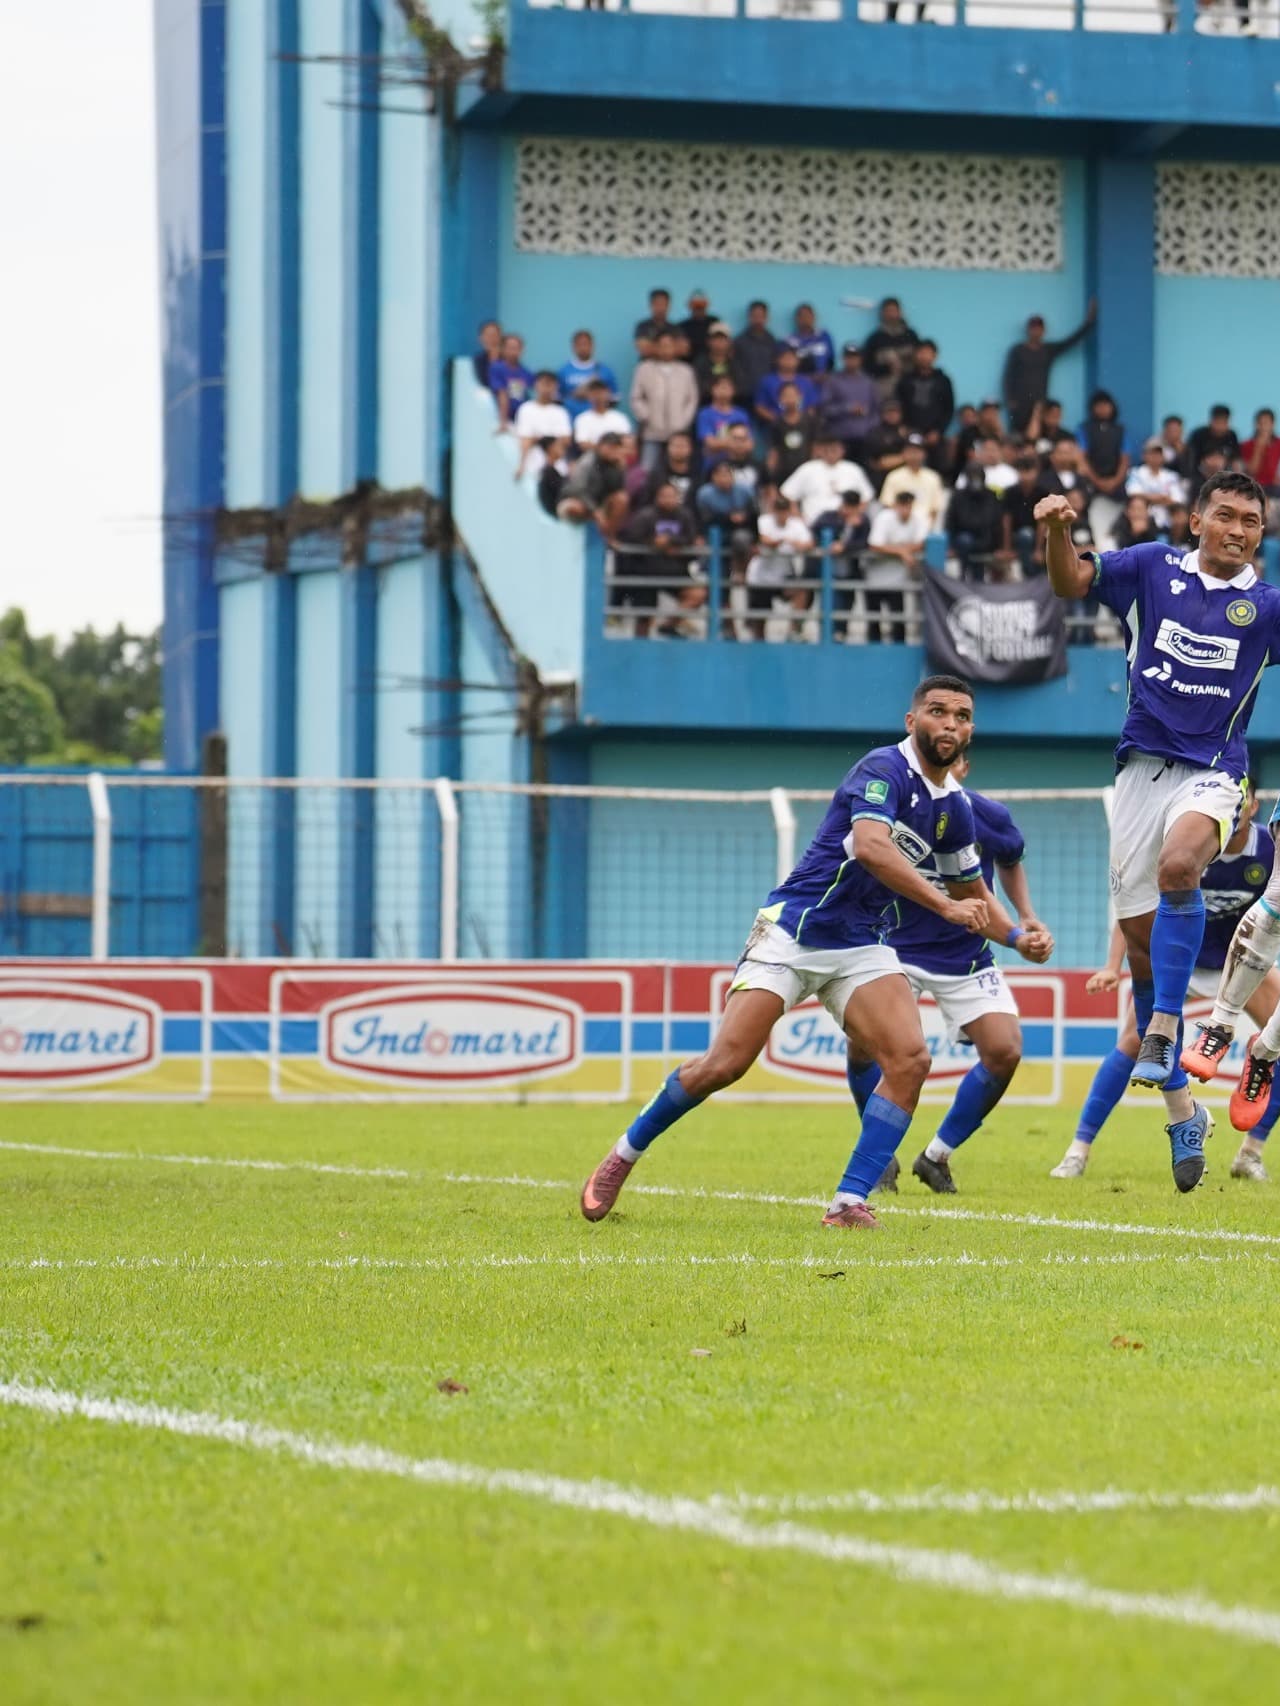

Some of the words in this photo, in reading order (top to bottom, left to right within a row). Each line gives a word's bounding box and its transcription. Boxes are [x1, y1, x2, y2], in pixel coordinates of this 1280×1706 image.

[1171, 634, 1223, 659] Indomaret
[1171, 679, 1231, 698] PERTAMINA
[342, 1014, 562, 1056] Indomaret
